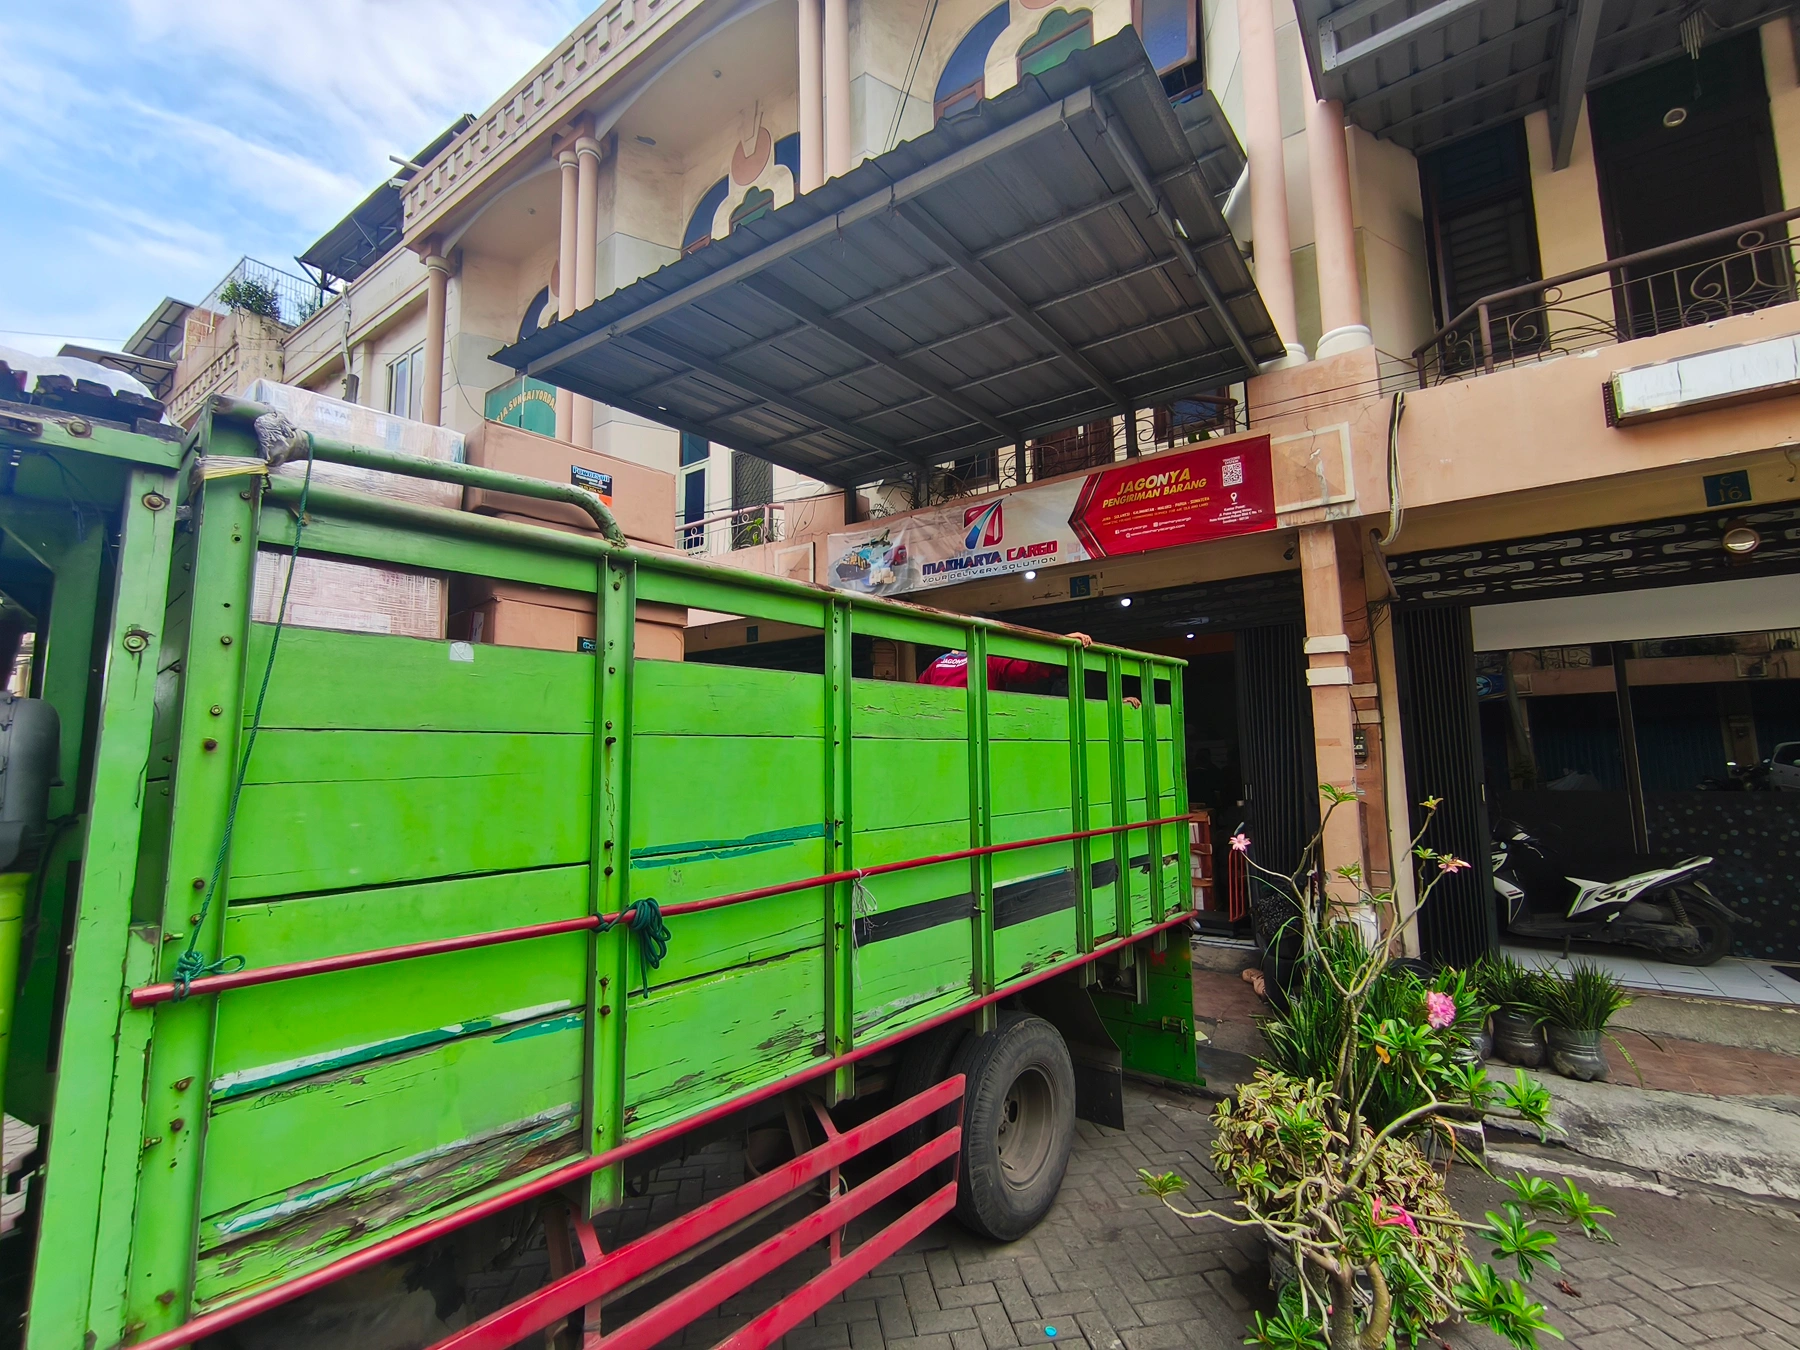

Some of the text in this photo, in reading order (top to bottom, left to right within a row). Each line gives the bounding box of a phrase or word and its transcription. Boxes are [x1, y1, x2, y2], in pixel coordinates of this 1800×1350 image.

[509, 390, 535, 411] SUNGAI
[1116, 468, 1191, 496] JAGONYA
[1720, 476, 1731, 486] C
[1102, 478, 1207, 509] PENGIRIMAN BARANG
[1719, 486, 1742, 501] 16
[922, 540, 1058, 576] MAKHARYA CARGO
[922, 556, 1056, 583] YOUR DELIVERY SOLUTION
[1076, 585, 1087, 595] 15
